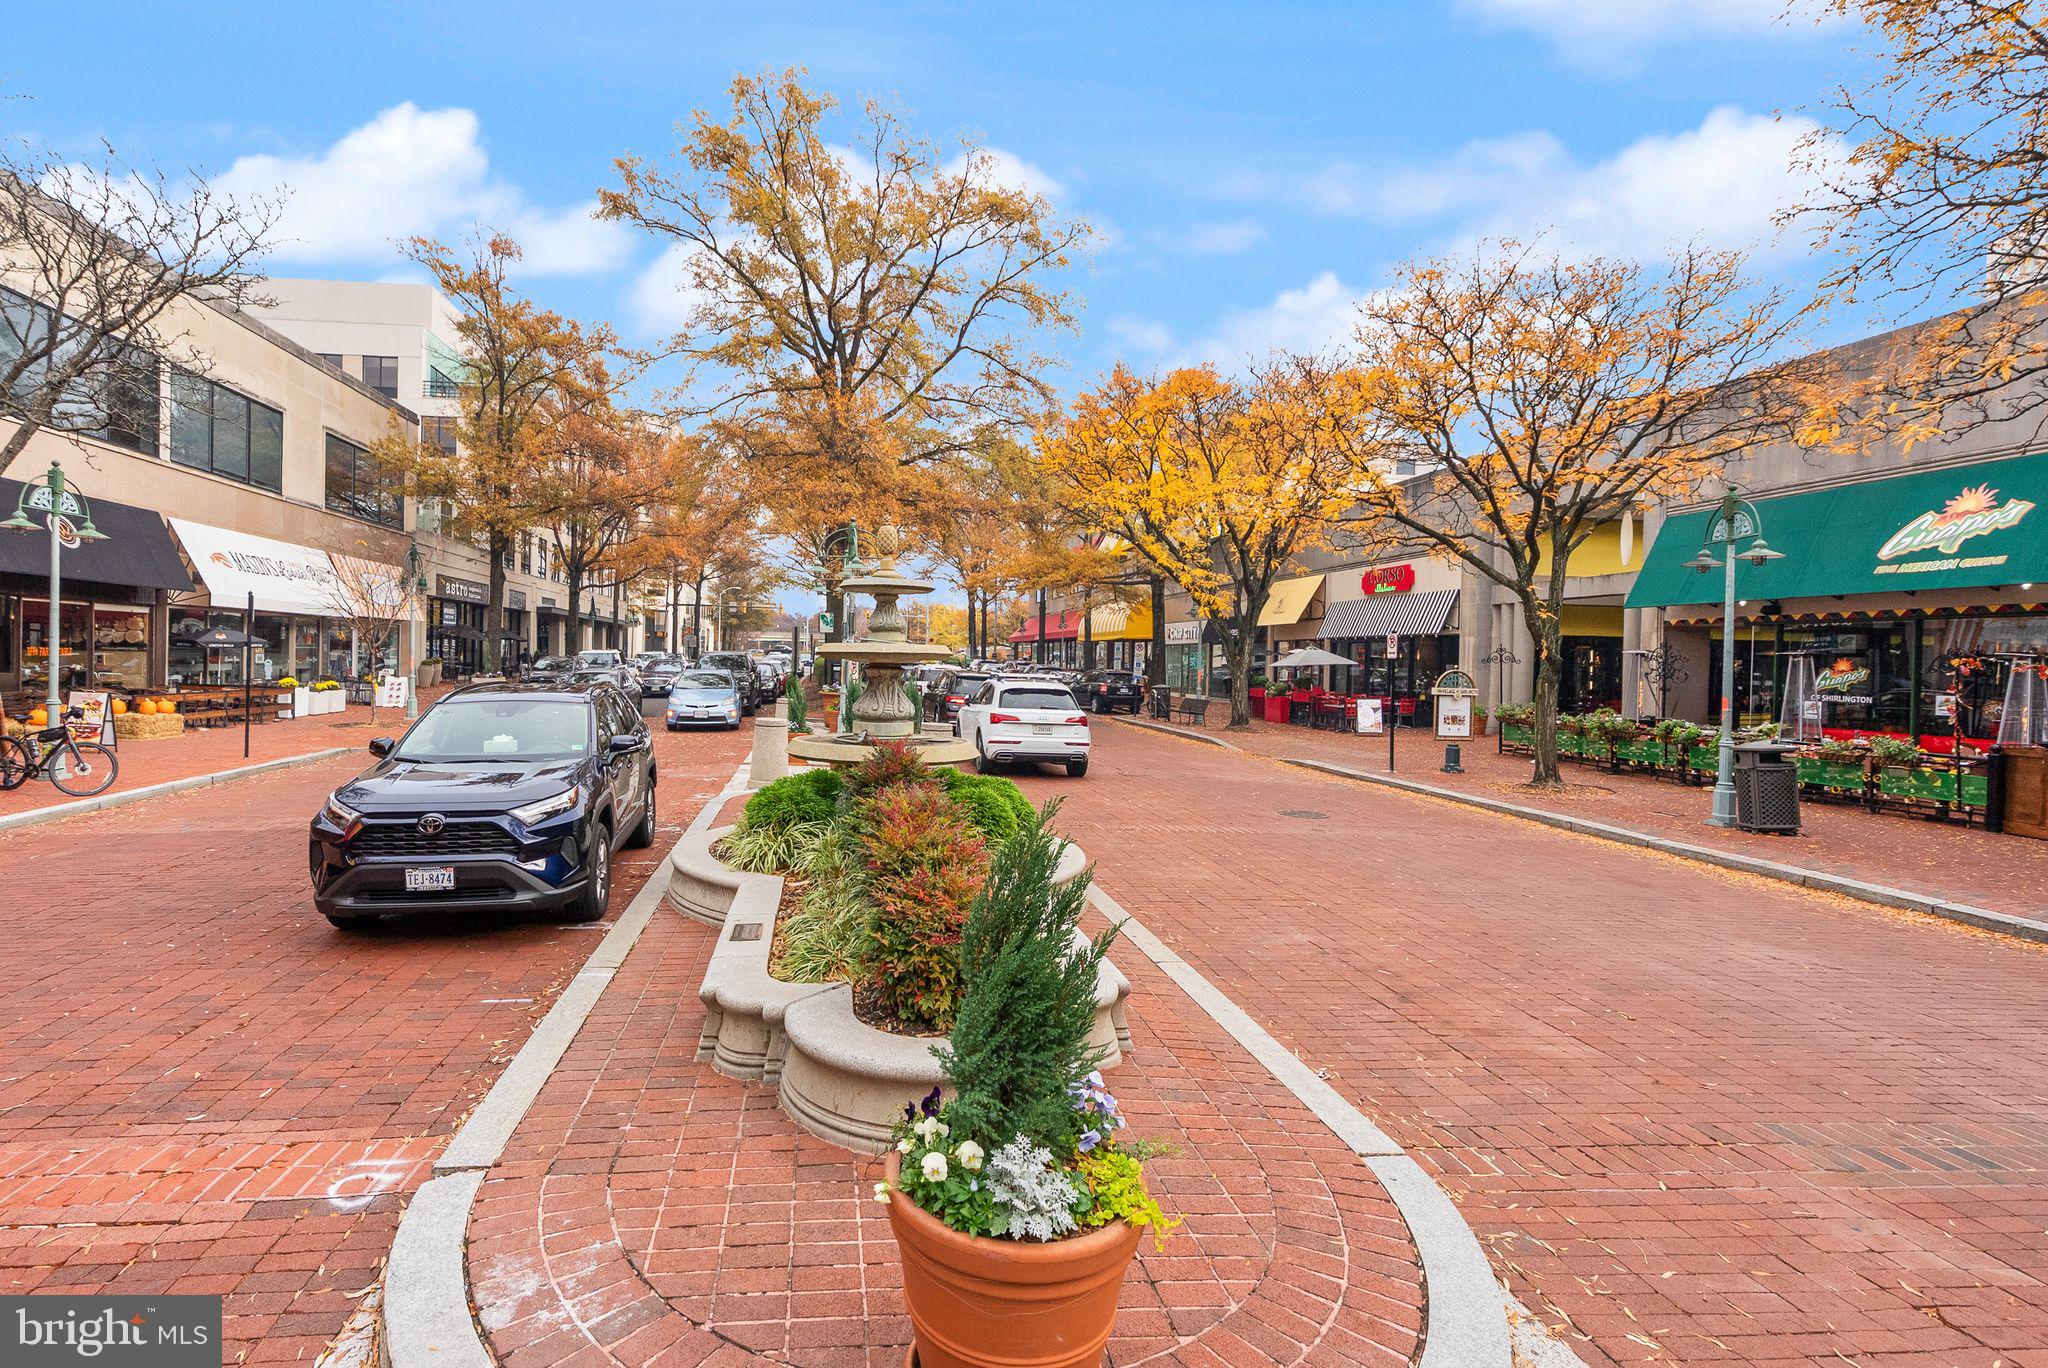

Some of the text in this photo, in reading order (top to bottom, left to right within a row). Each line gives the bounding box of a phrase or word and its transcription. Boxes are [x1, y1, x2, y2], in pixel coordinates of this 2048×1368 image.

[1881, 503, 2026, 556] Guapo's
[228, 550, 280, 577] MASON'S
[1896, 558, 1960, 573] MEXICAN
[446, 581, 468, 597] astro
[1815, 668, 1867, 690] Guapo's
[1821, 694, 1873, 704] SHIRLINGTON
[407, 873, 453, 886] TEJ-8474
